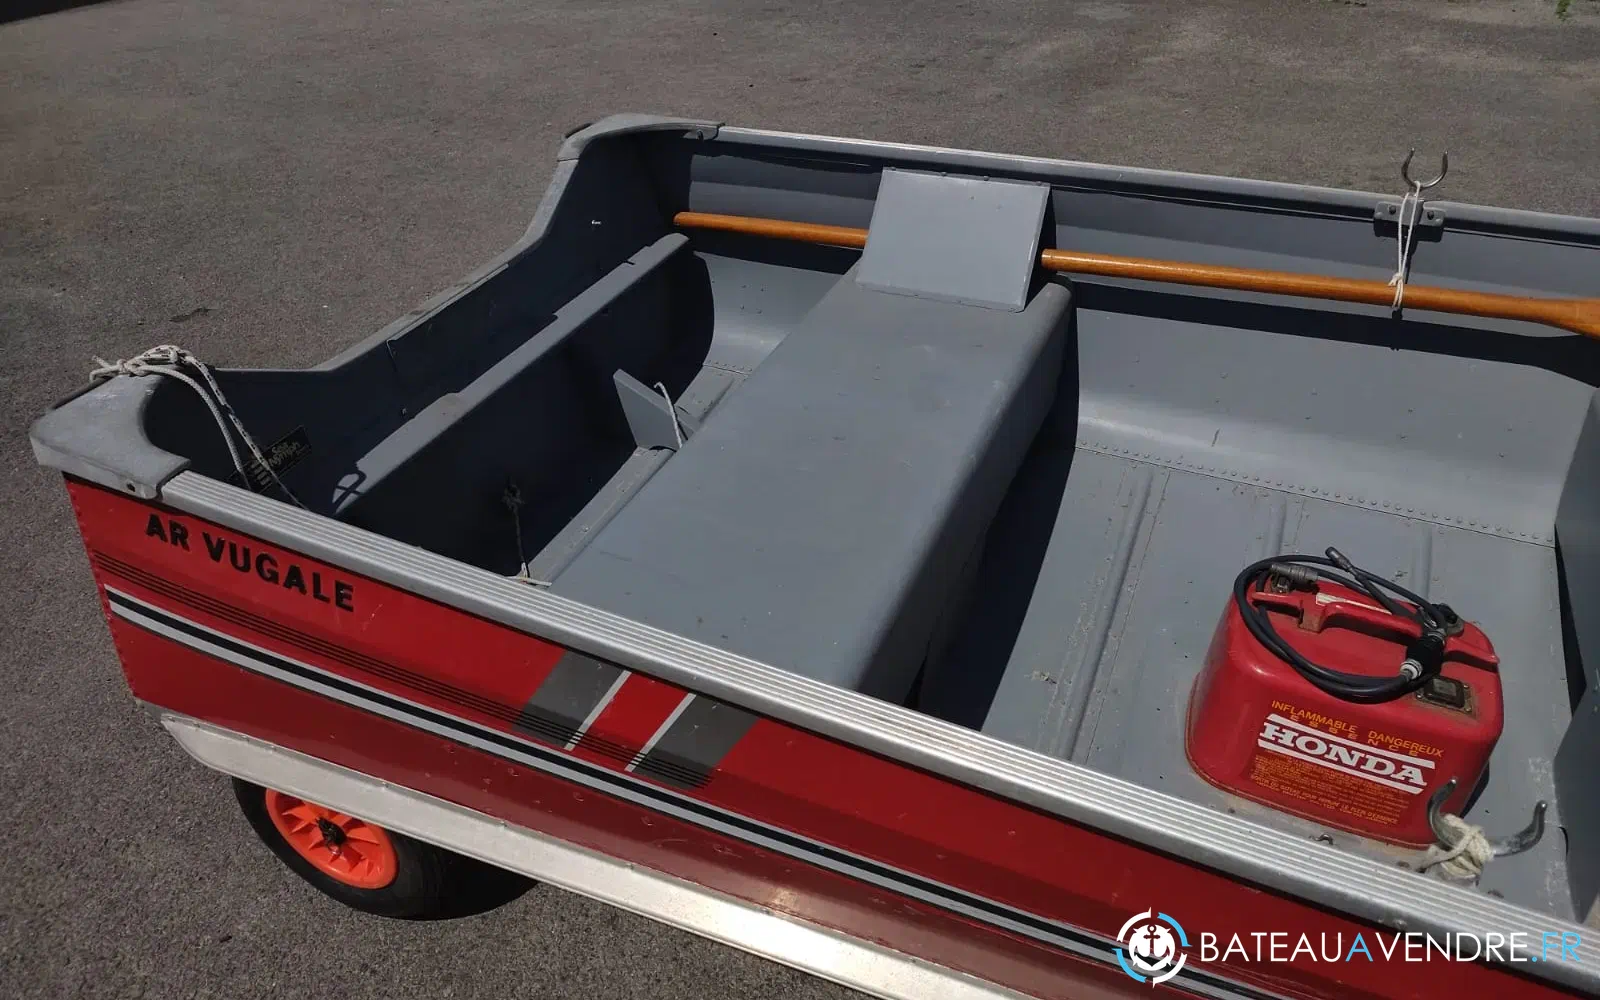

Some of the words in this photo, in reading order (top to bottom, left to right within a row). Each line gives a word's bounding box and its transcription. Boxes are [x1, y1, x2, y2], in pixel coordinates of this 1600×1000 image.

[146, 513, 191, 552] AR
[202, 531, 355, 613] VUGALE
[1259, 722, 1428, 787] HONDA
[1271, 700, 1358, 734] INFLAMMABLE
[1367, 730, 1445, 757] DANGEREUX
